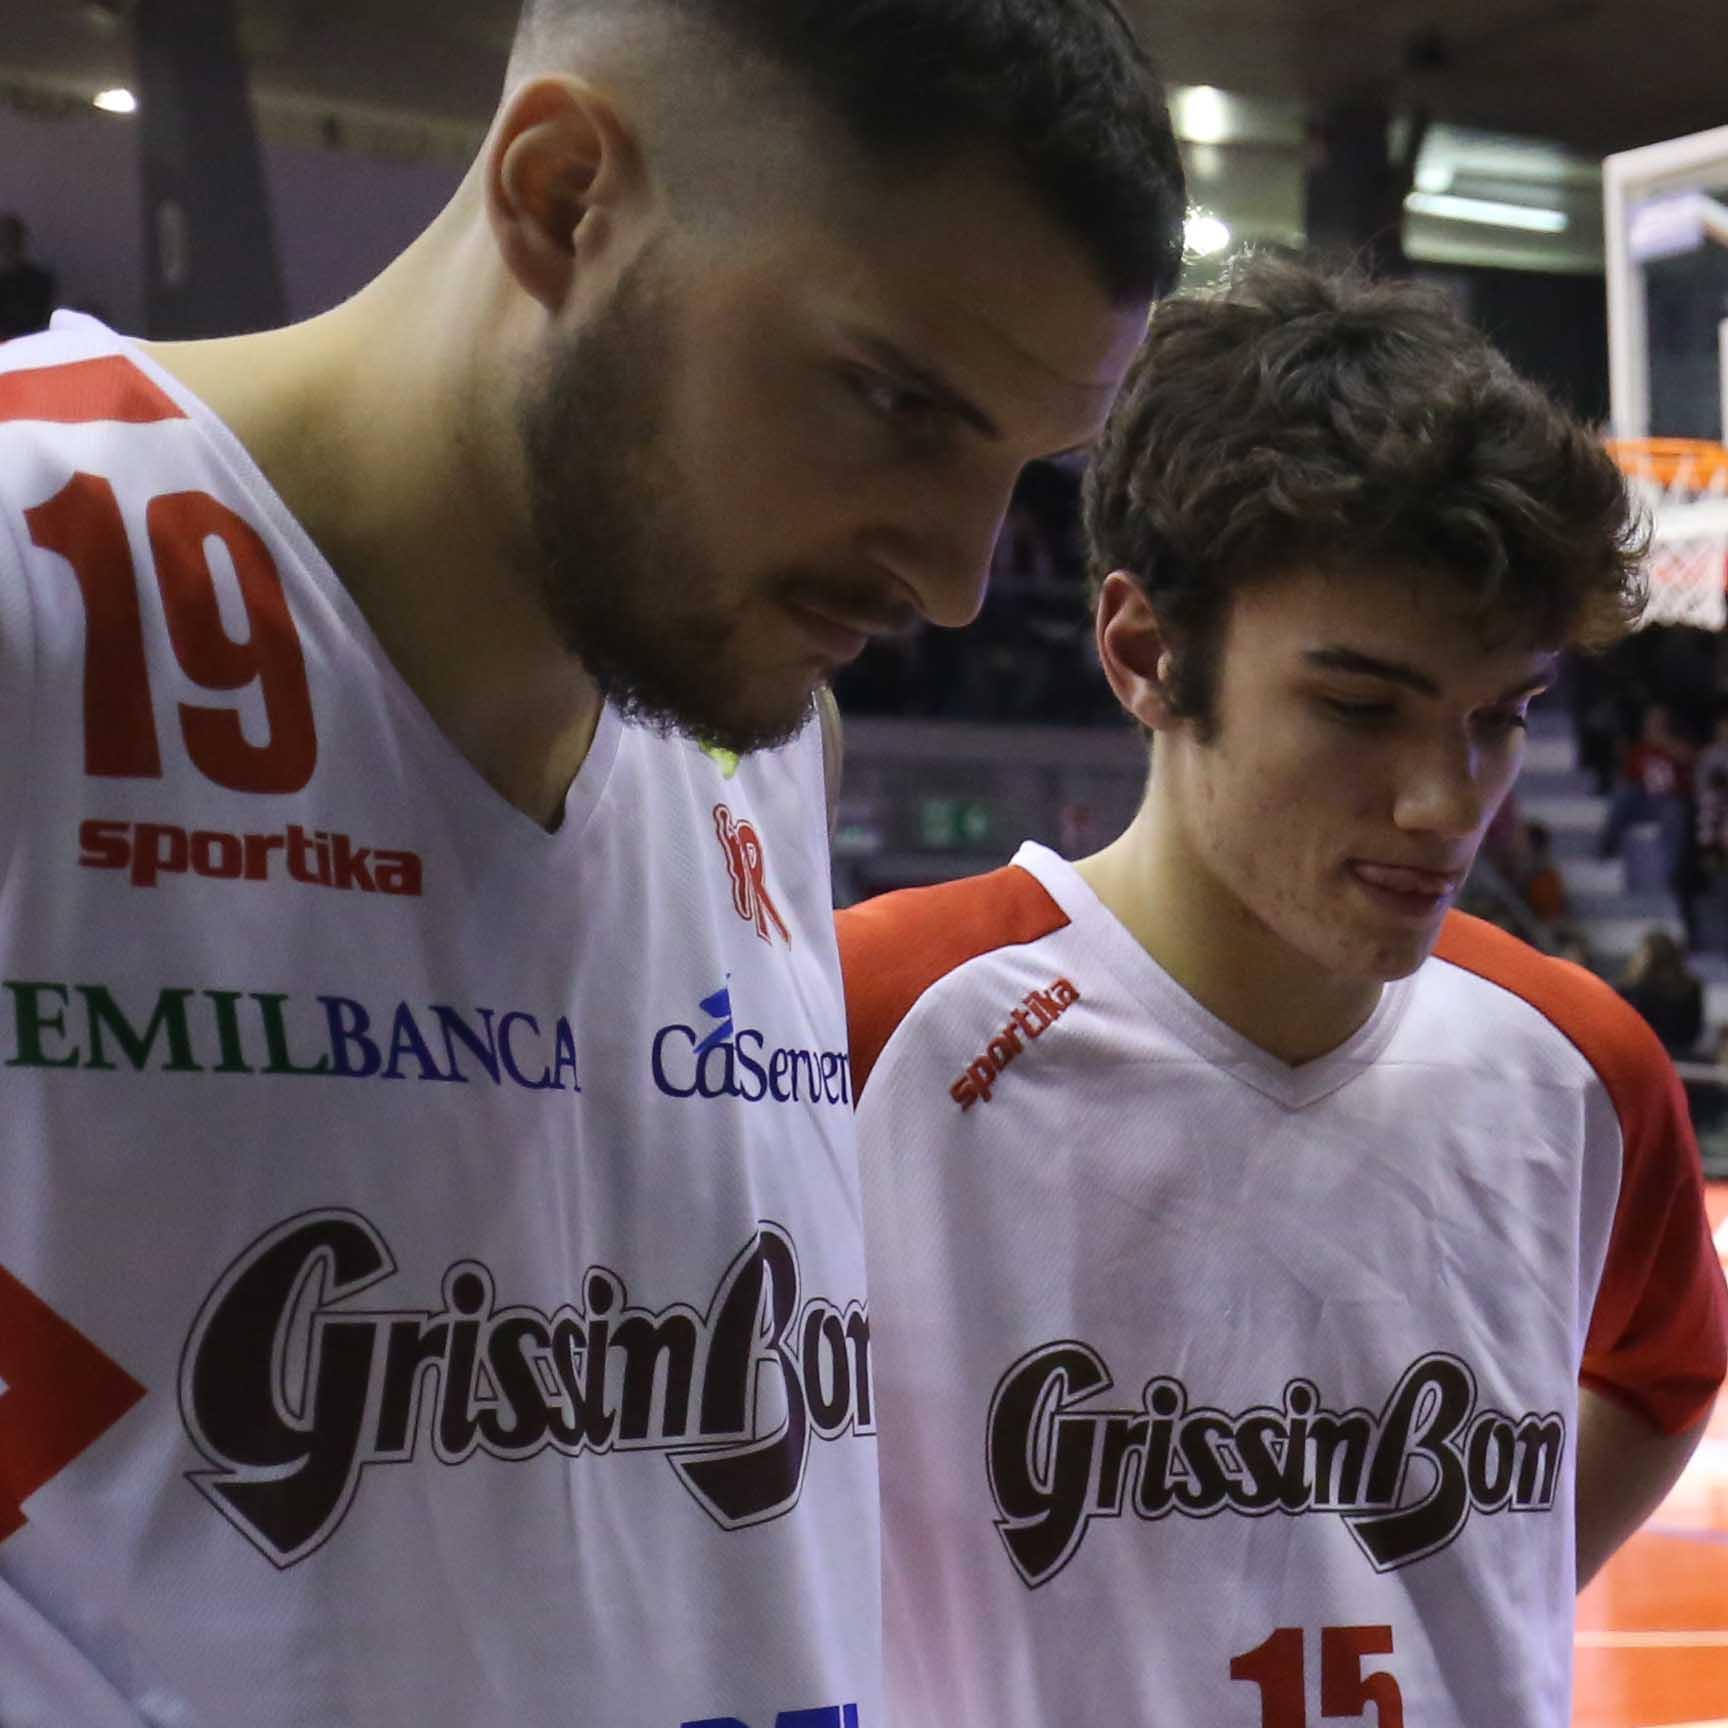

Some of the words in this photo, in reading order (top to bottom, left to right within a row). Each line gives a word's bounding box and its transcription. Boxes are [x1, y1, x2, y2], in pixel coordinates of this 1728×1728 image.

[22, 471, 318, 795] 19
[78, 816, 423, 897] sportika
[2, 980, 582, 1094] EMILBANCA
[948, 973, 1081, 1112] sportika
[986, 1339, 1565, 1590] GrissinBon
